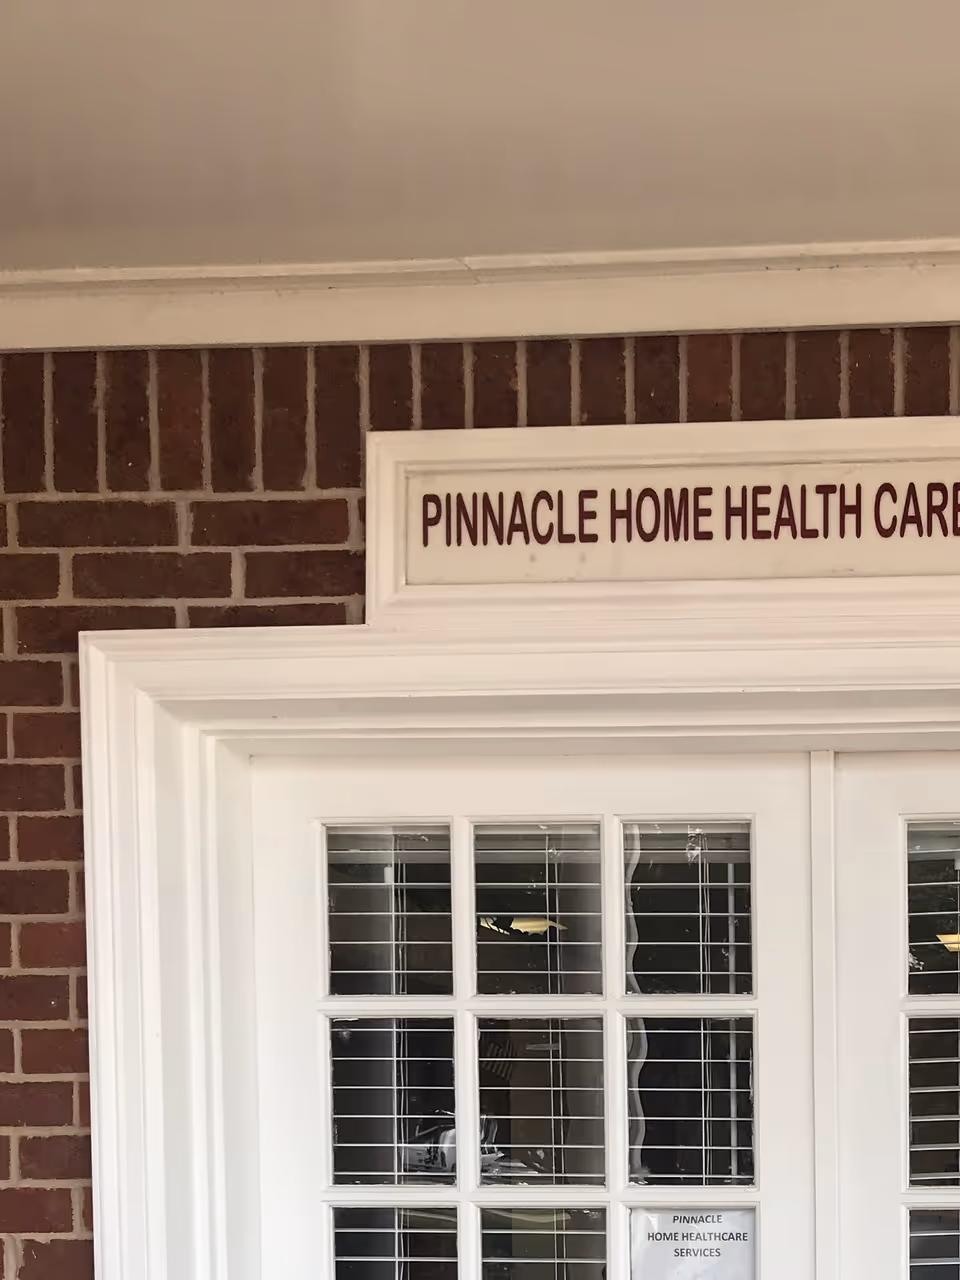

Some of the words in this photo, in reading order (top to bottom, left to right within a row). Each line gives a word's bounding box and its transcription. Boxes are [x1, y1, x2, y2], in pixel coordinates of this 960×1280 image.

[422, 490, 599, 548] PINNACLE
[609, 486, 713, 544] HOME
[724, 482, 862, 542] HEALTH
[673, 1215, 722, 1224] PINNACLE
[648, 1232, 678, 1241] HOME
[682, 1232, 748, 1241] HEALTHCARE
[674, 1248, 721, 1257] SERVICES
